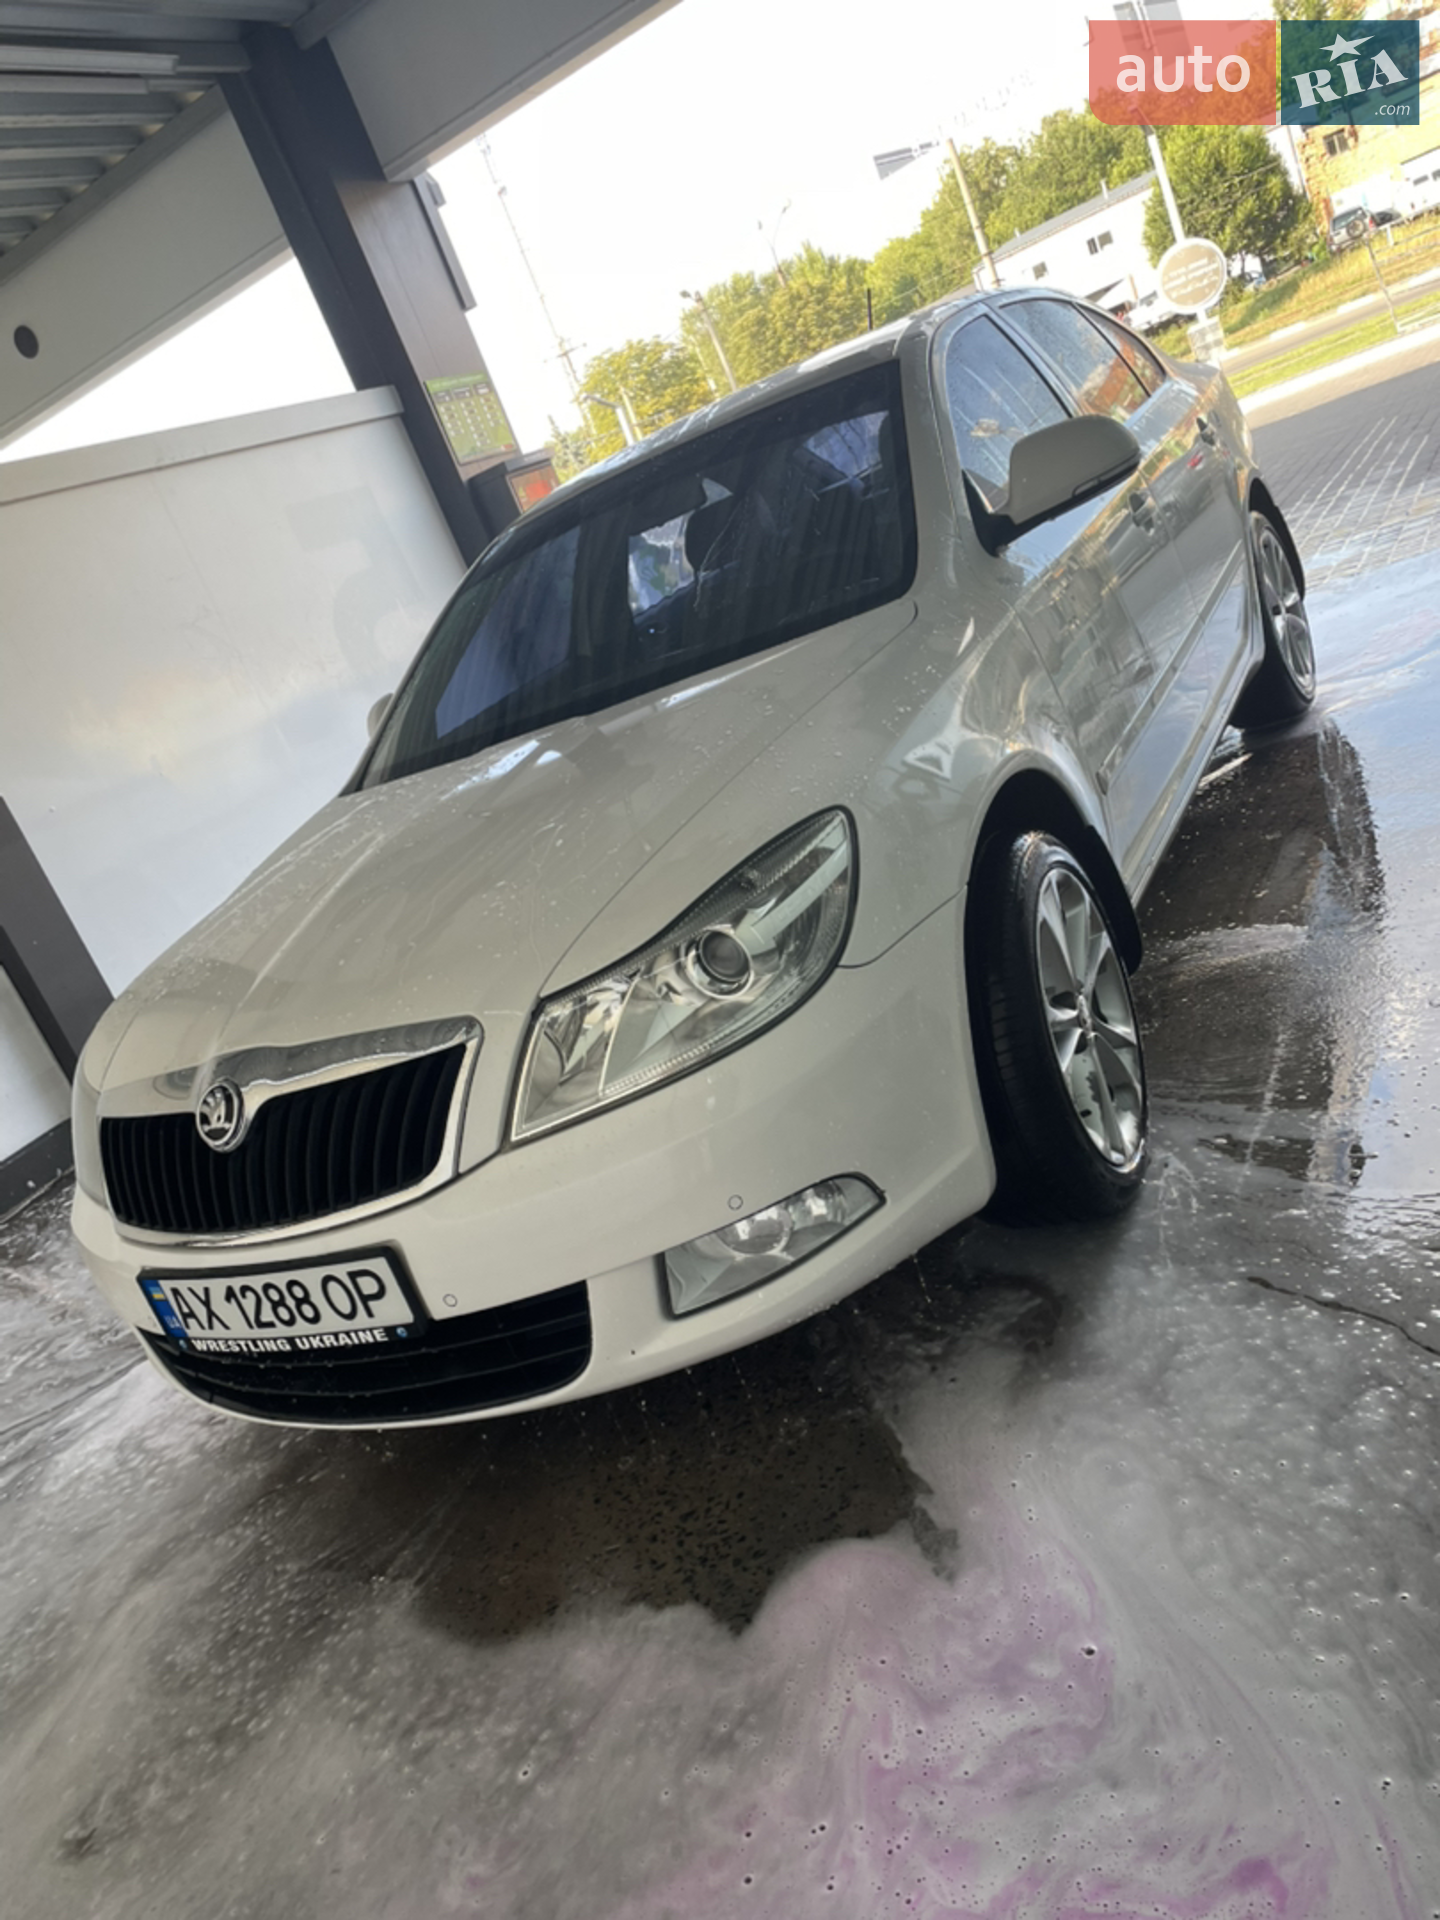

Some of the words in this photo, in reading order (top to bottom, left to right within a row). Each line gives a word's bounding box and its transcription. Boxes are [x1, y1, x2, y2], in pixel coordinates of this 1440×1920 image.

[170, 1286, 230, 1330] AX
[224, 1279, 322, 1330] 1288
[320, 1268, 387, 1322] OP
[191, 1338, 292, 1353] WRESTLING
[295, 1328, 388, 1350] UKRAINE
